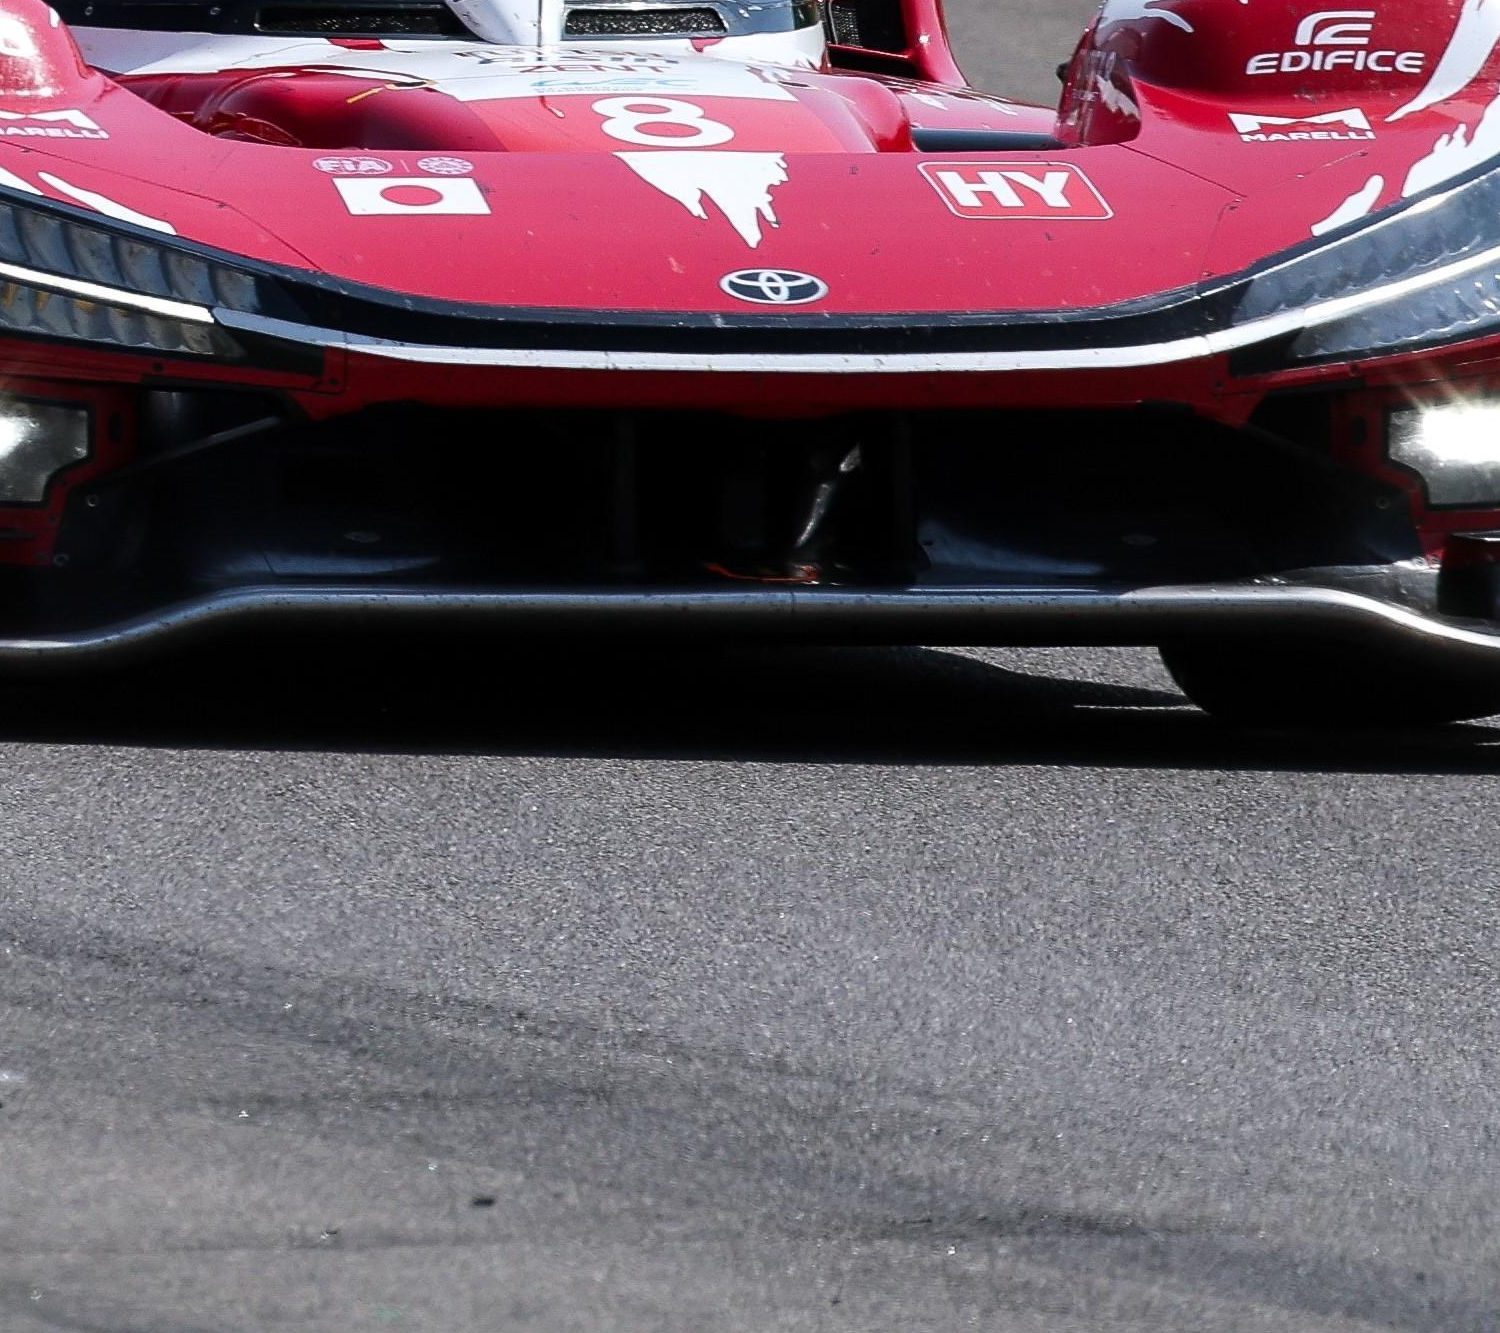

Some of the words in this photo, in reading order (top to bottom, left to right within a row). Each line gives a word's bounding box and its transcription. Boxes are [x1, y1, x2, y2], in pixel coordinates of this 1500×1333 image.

[1246, 50, 1425, 75] EDIFICE
[590, 96, 736, 148] 8
[1240, 132, 1377, 142] MARELLI
[953, 166, 1071, 209] HY
